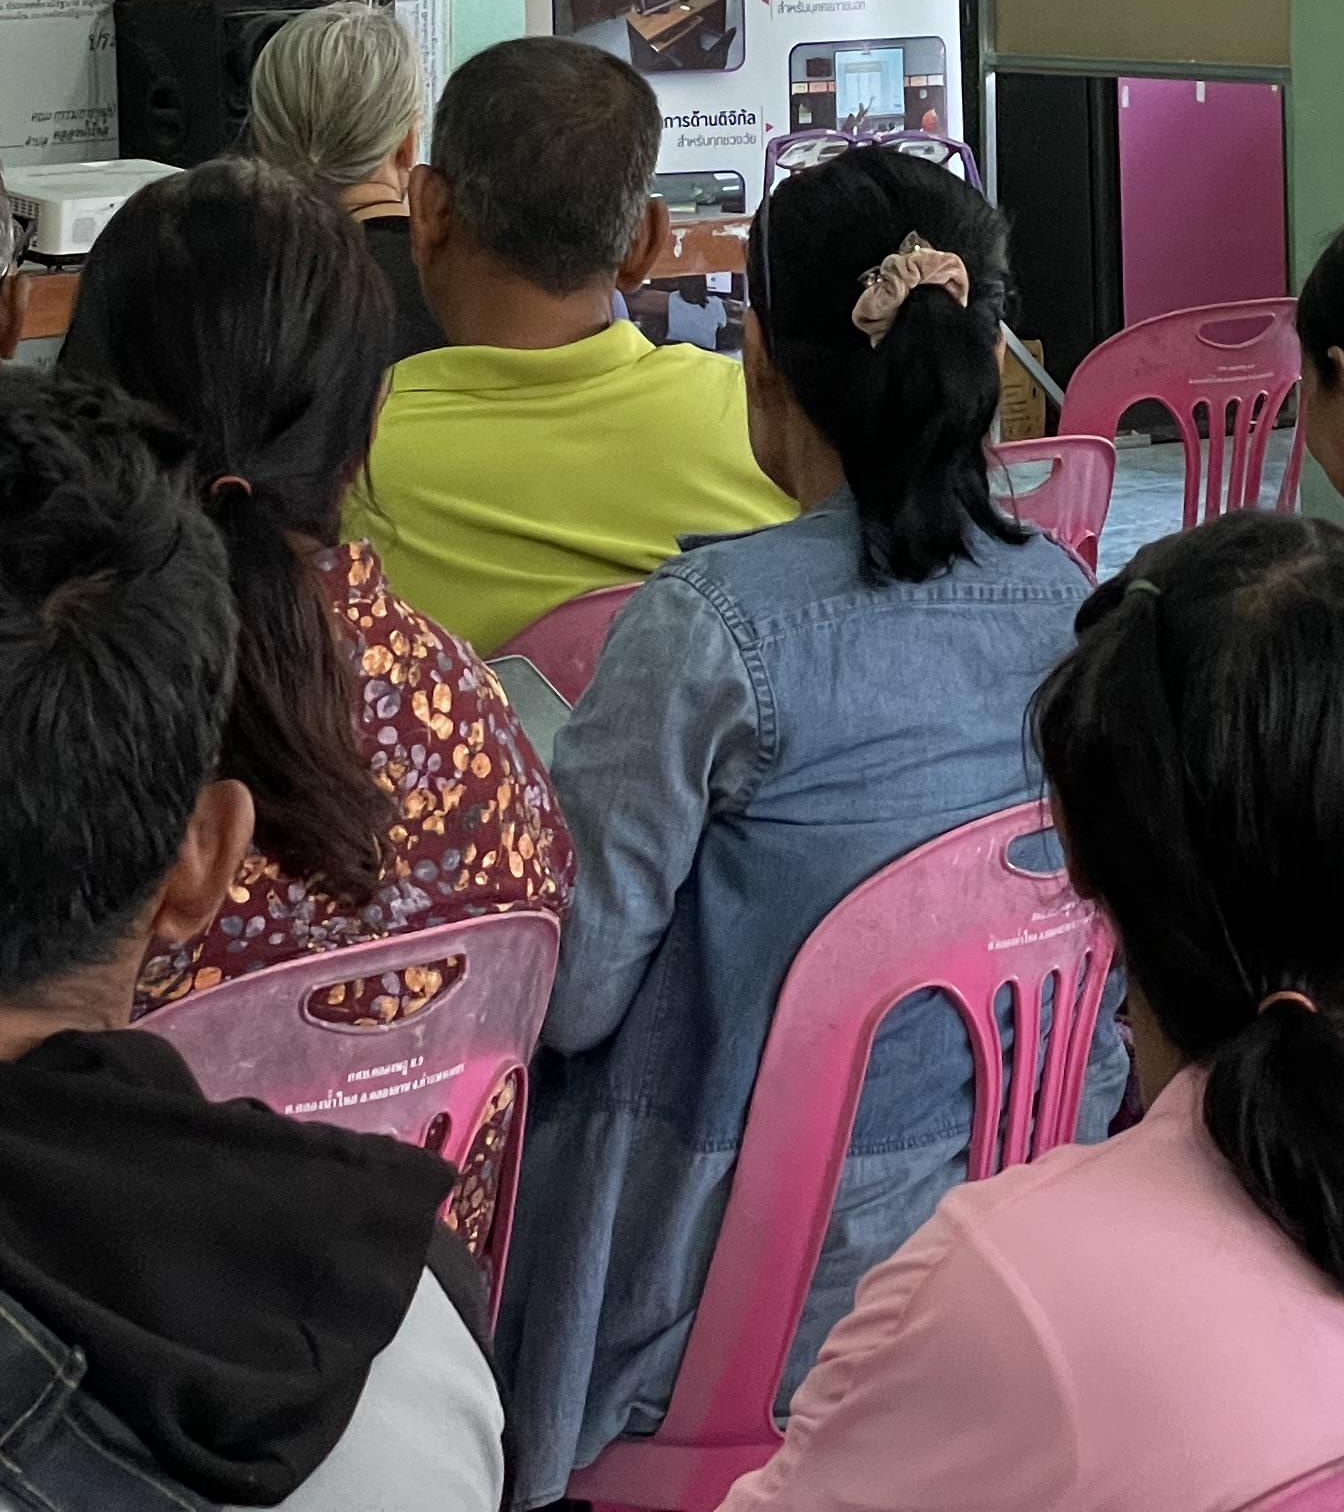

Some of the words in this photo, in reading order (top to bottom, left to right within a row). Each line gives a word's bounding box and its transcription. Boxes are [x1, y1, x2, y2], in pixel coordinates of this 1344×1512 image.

[664, 108, 756, 128] การด้านดิจิทัล
